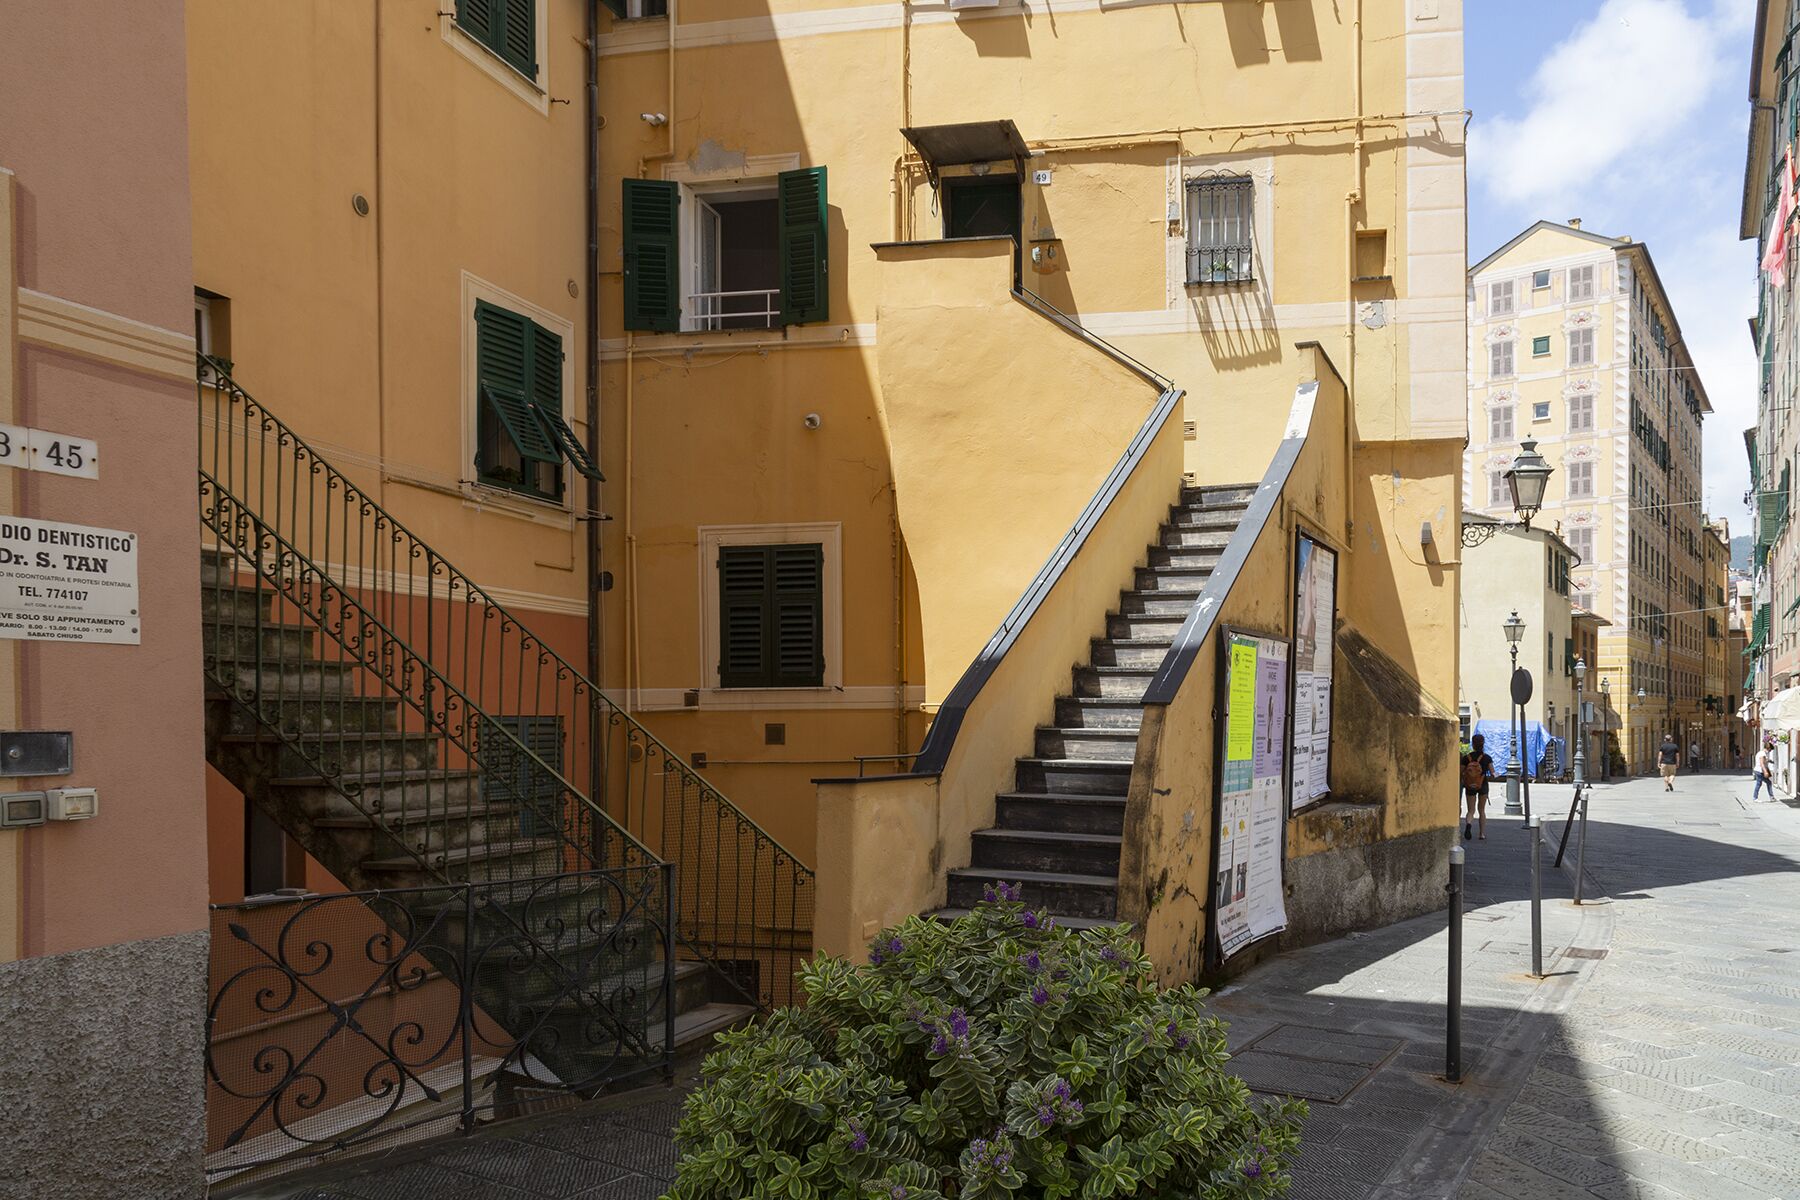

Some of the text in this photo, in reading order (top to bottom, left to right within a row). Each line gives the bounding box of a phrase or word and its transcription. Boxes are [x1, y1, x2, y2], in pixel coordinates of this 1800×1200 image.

[1036, 173, 1047, 182] 49
[46, 441, 83, 469] 45
[38, 528, 131, 552] DENTISTICO
[0, 547, 108, 573] Dr. S. TAN
[15, 572, 66, 583] ODONTOIATRIA
[72, 578, 101, 586] PROTESI
[101, 580, 132, 588] DENTARIA
[18, 586, 89, 601] TEL. 774107
[56, 616, 126, 626] APPUNTAMENTO
